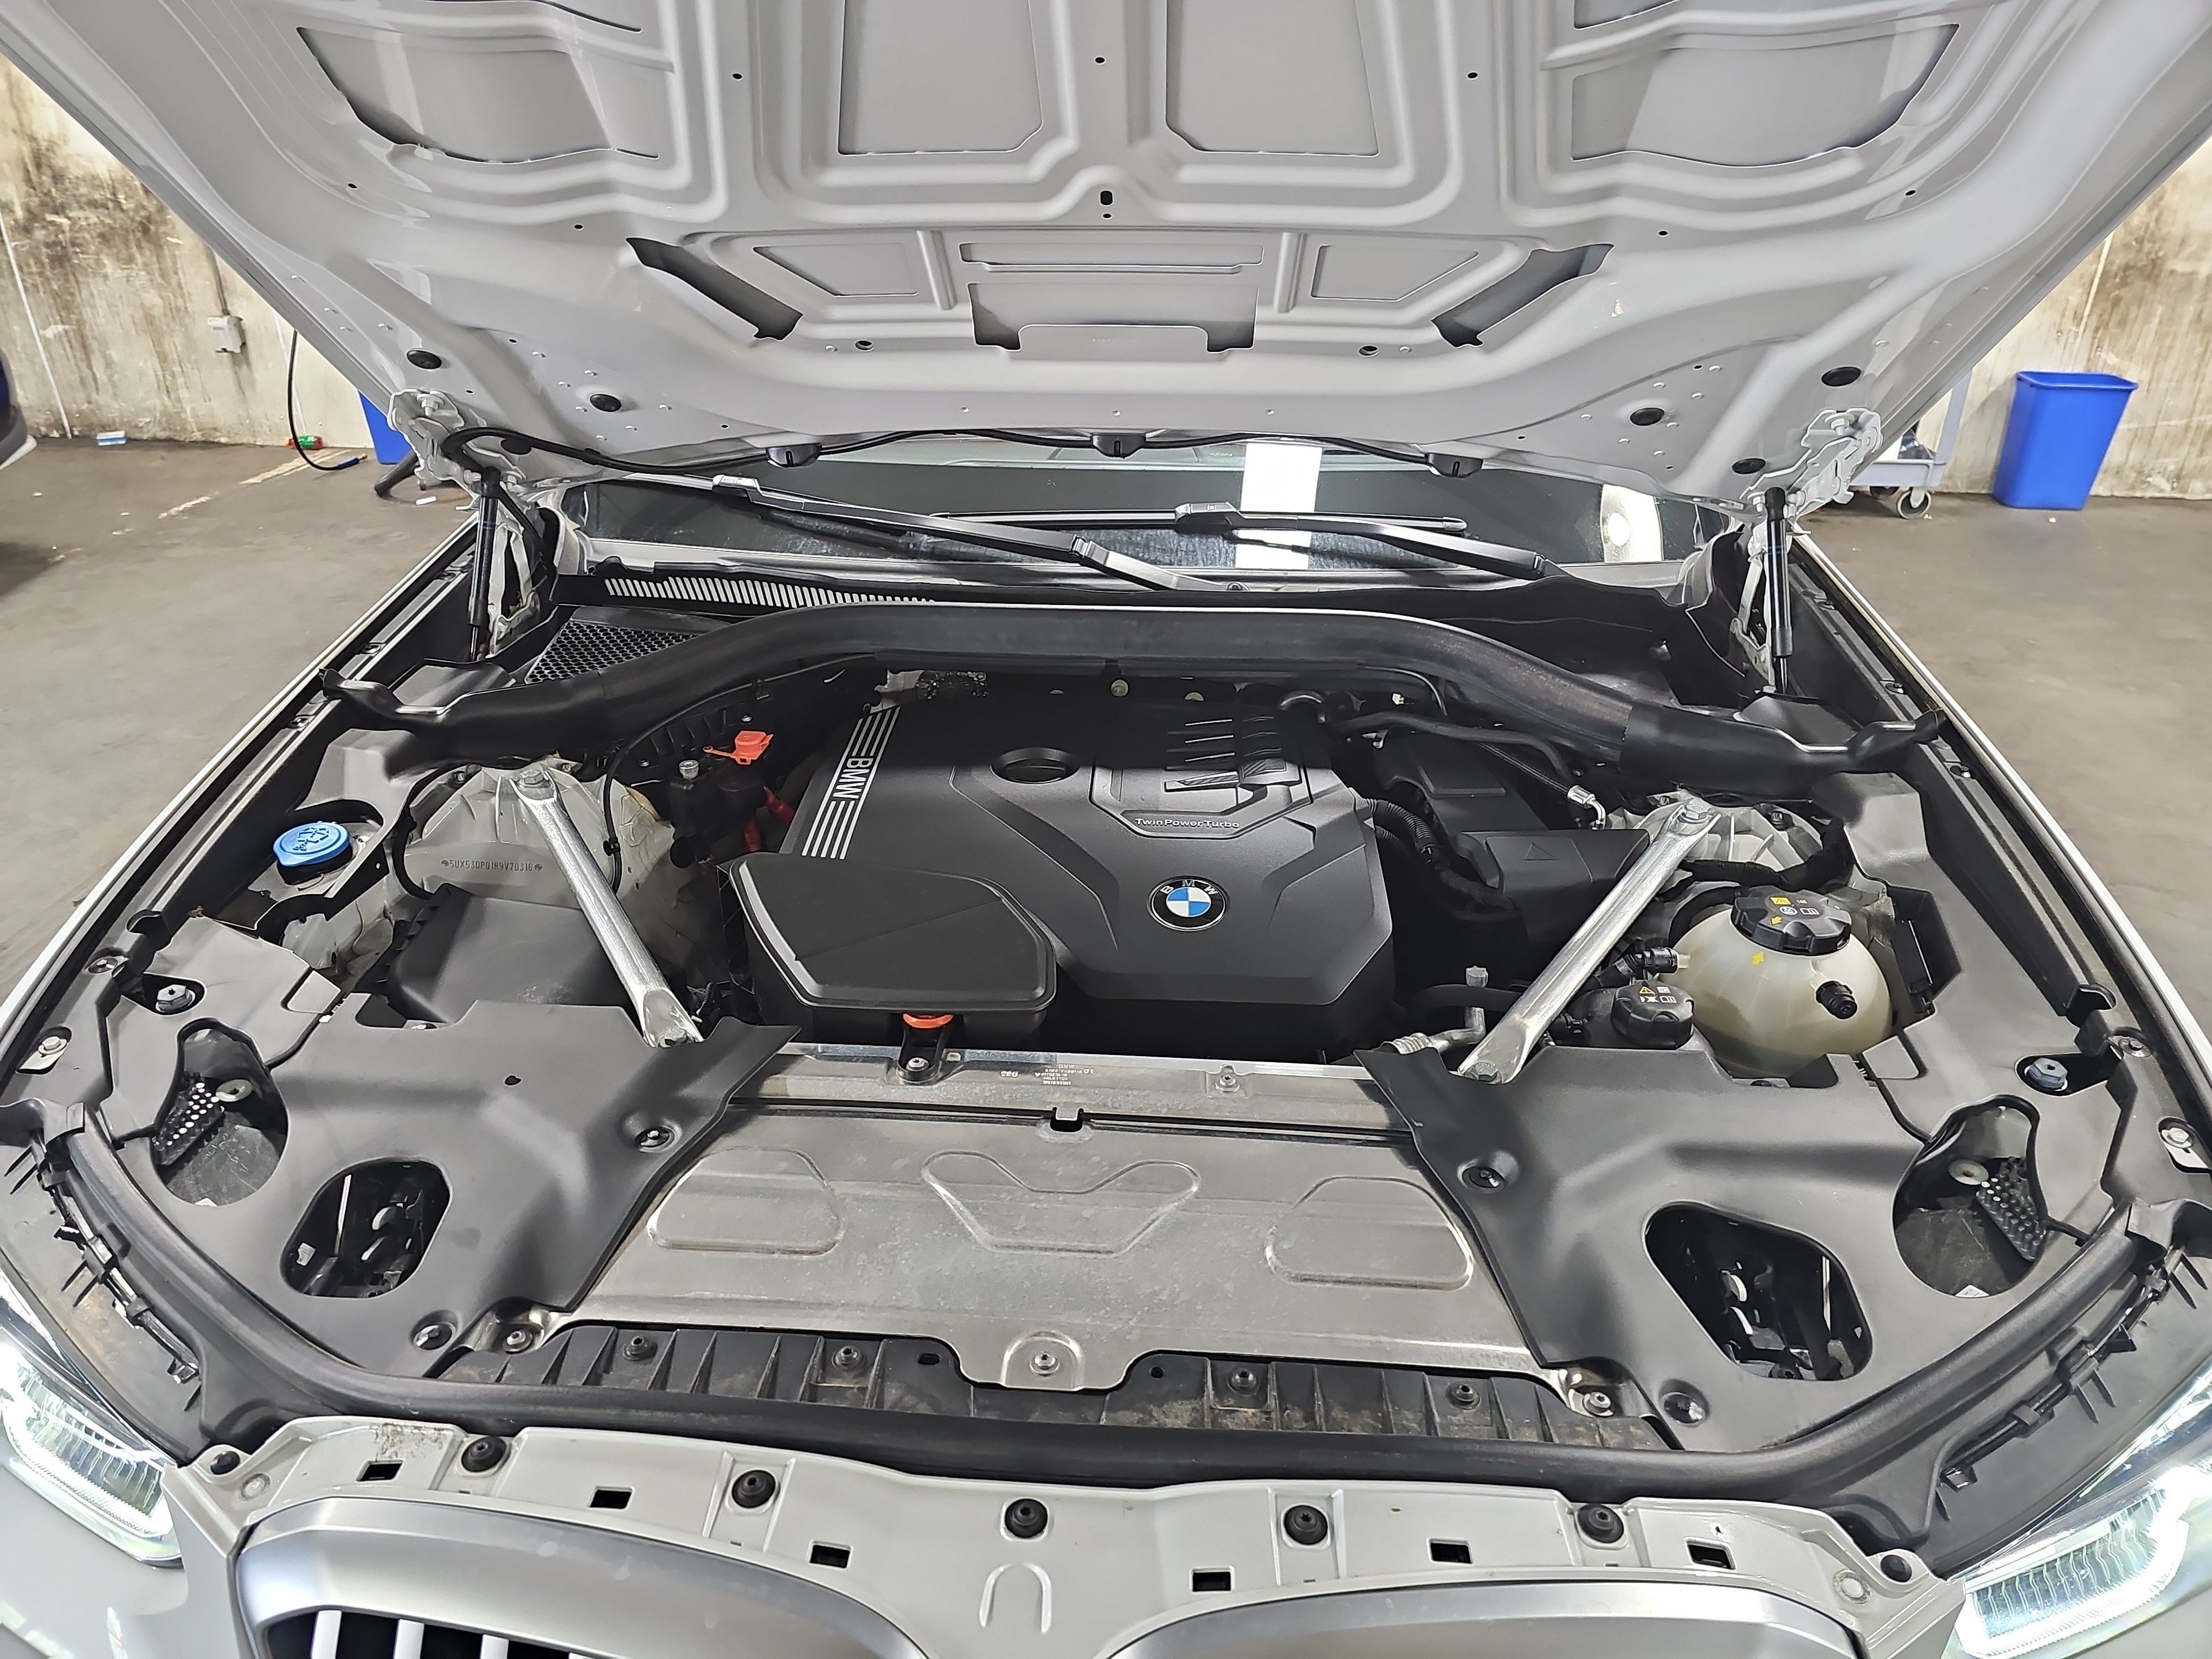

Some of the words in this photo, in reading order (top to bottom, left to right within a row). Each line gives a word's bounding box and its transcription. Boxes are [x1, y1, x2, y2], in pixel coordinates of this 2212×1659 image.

[833, 758, 873, 799] BMW
[1204, 820, 1239, 828] Turbo
[1160, 879, 1219, 895] BMW
